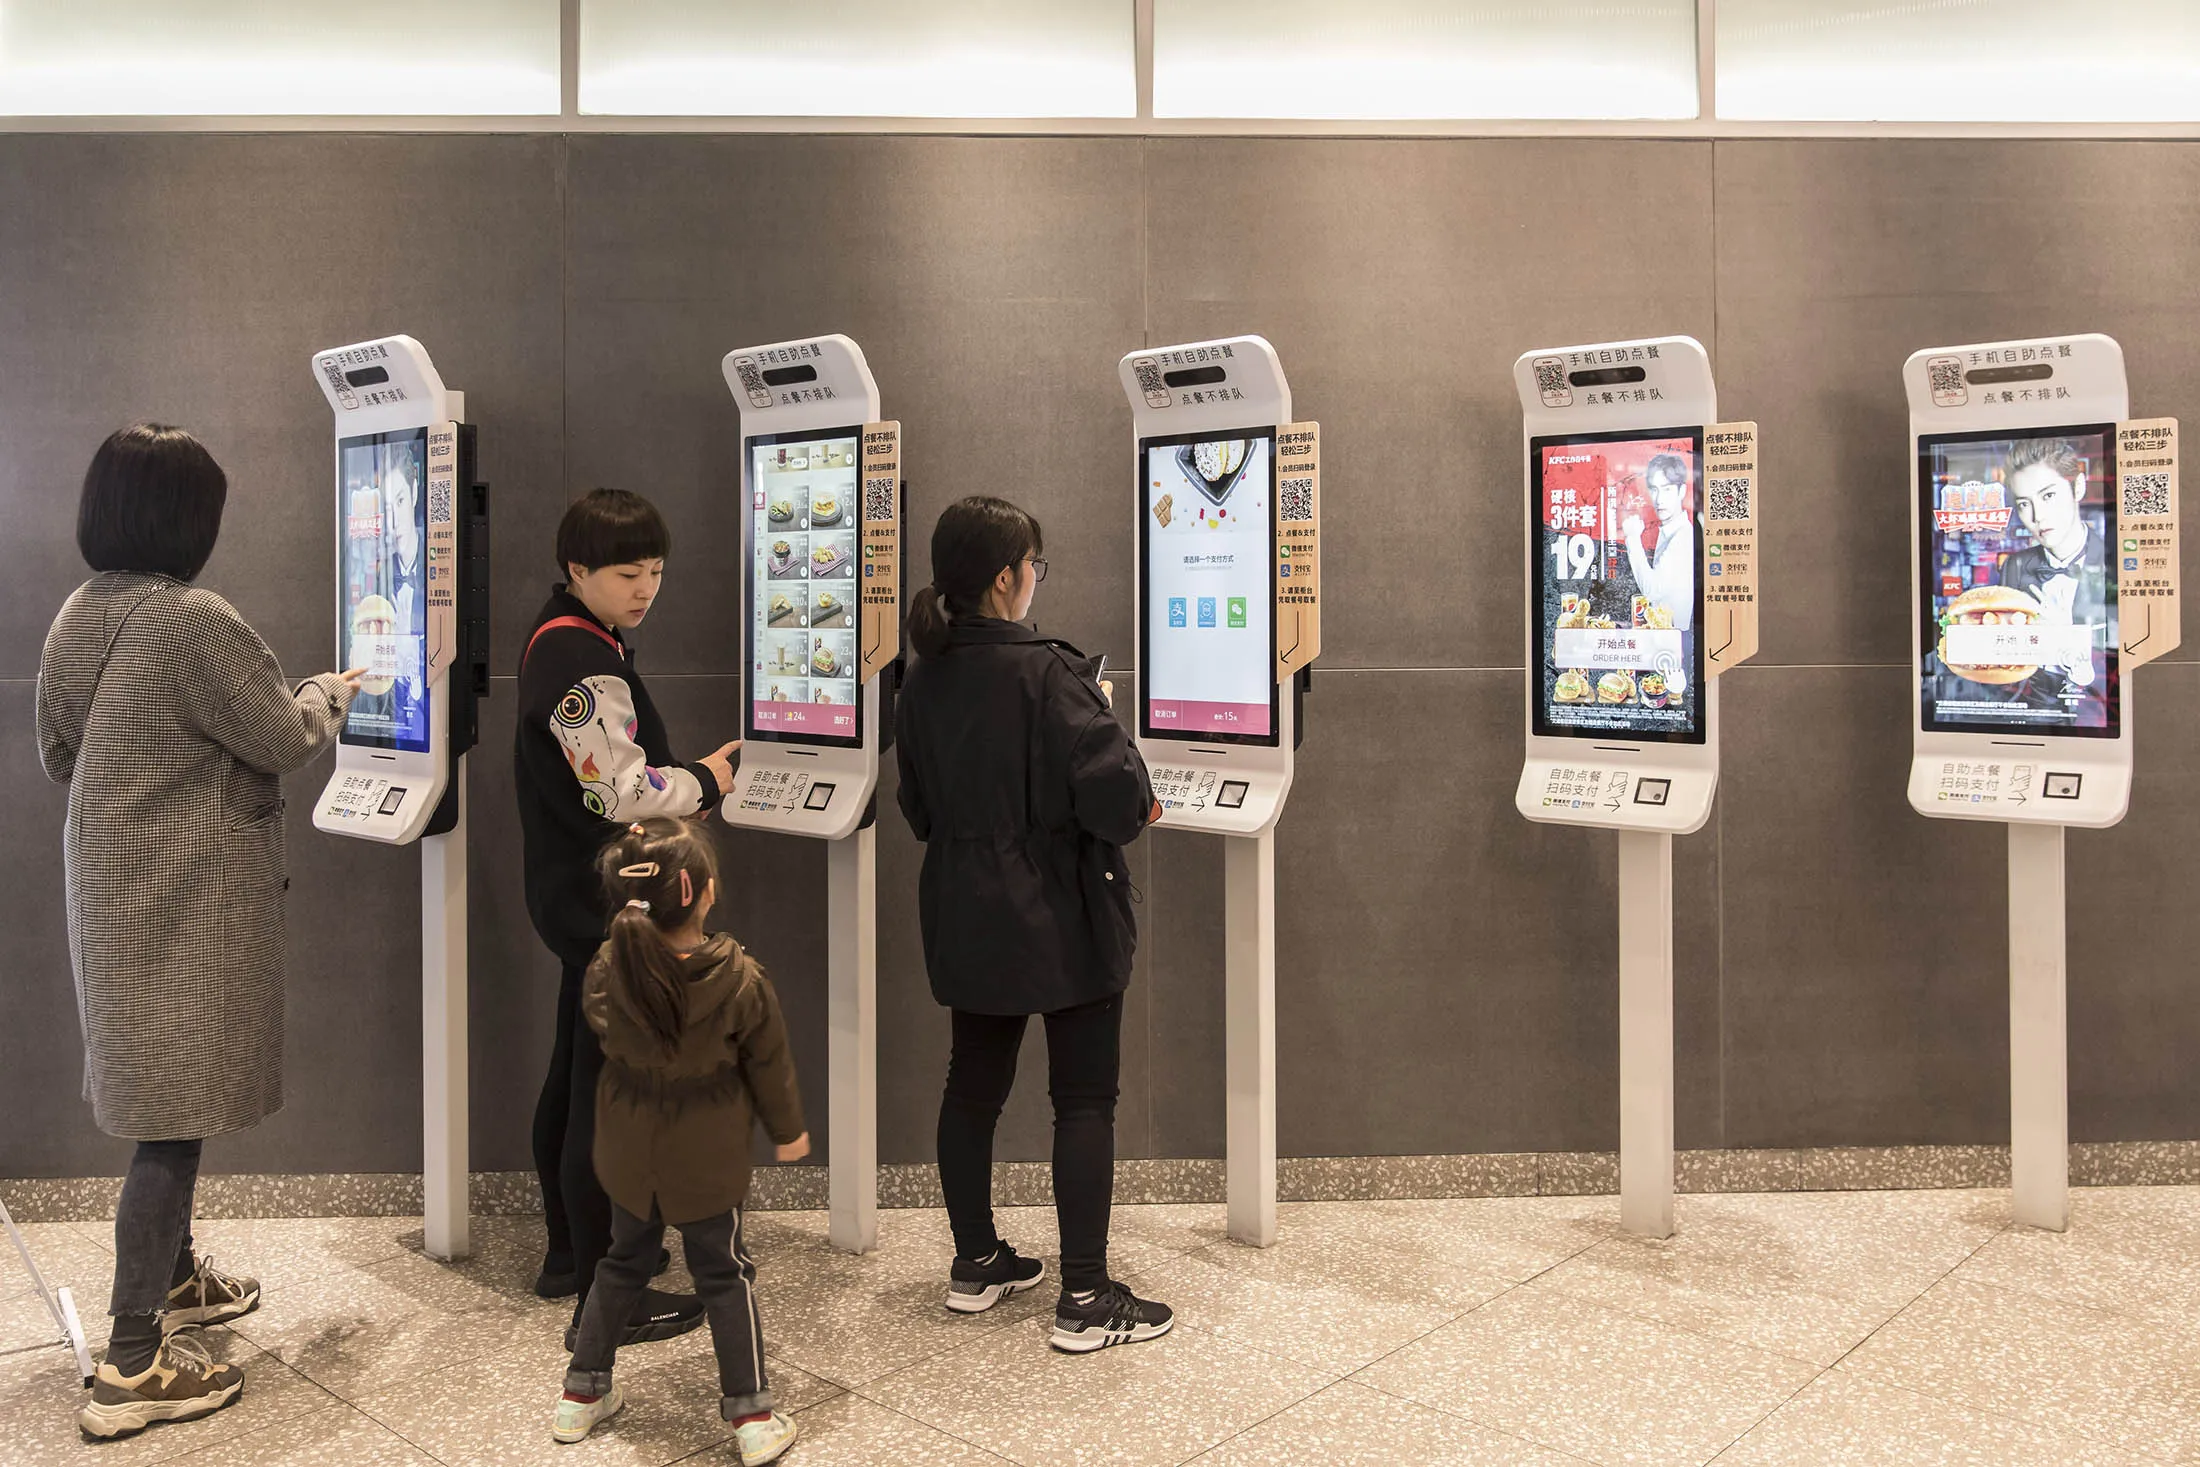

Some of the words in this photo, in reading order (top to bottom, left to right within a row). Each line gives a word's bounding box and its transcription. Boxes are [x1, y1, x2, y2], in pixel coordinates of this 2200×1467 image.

[337, 344, 389, 366] 手机自助点餐
[757, 343, 823, 366] 手机自助点餐
[1160, 345, 1234, 367] 手机自助点餐
[1569, 345, 1660, 367] 手机自助点餐
[1969, 344, 2072, 366] 手机自助点餐
[364, 386, 407, 406] 点餐不排队
[780, 385, 837, 405] 点餐不排队
[1181, 387, 1245, 406] 点餐不排队
[1587, 387, 1664, 405] 点餐不排队
[1983, 387, 2071, 405] 点餐不排队
[864, 431, 897, 443] 点餐不排队
[1278, 431, 1315, 444] 点餐不排队
[1706, 432, 1753, 444] 点餐不排队
[2119, 428, 2173, 440] 点餐不排队
[867, 444, 893, 455] 轻松三步
[1281, 444, 1312, 456] 轻松三步
[1710, 444, 1749, 456] 轻松三步
[2124, 440, 2168, 451] 轻松三步
[1551, 488, 1576, 504] 硬核
[1551, 505, 1597, 529] 3件套
[1551, 533, 1595, 579] 19
[1598, 638, 1636, 650] 开始点餐
[1592, 654, 1619, 662] ORDER
[1621, 655, 1642, 663] HERE
[753, 770, 791, 784] 自助点餐
[1152, 768, 1195, 783] 自助点餐
[1550, 768, 1602, 783] 自助点餐
[1943, 763, 2000, 776] 自助点餐
[746, 784, 784, 799] 扫码支付
[1546, 782, 1599, 798] 扫码支付
[1940, 777, 2000, 792] 扫码支付
